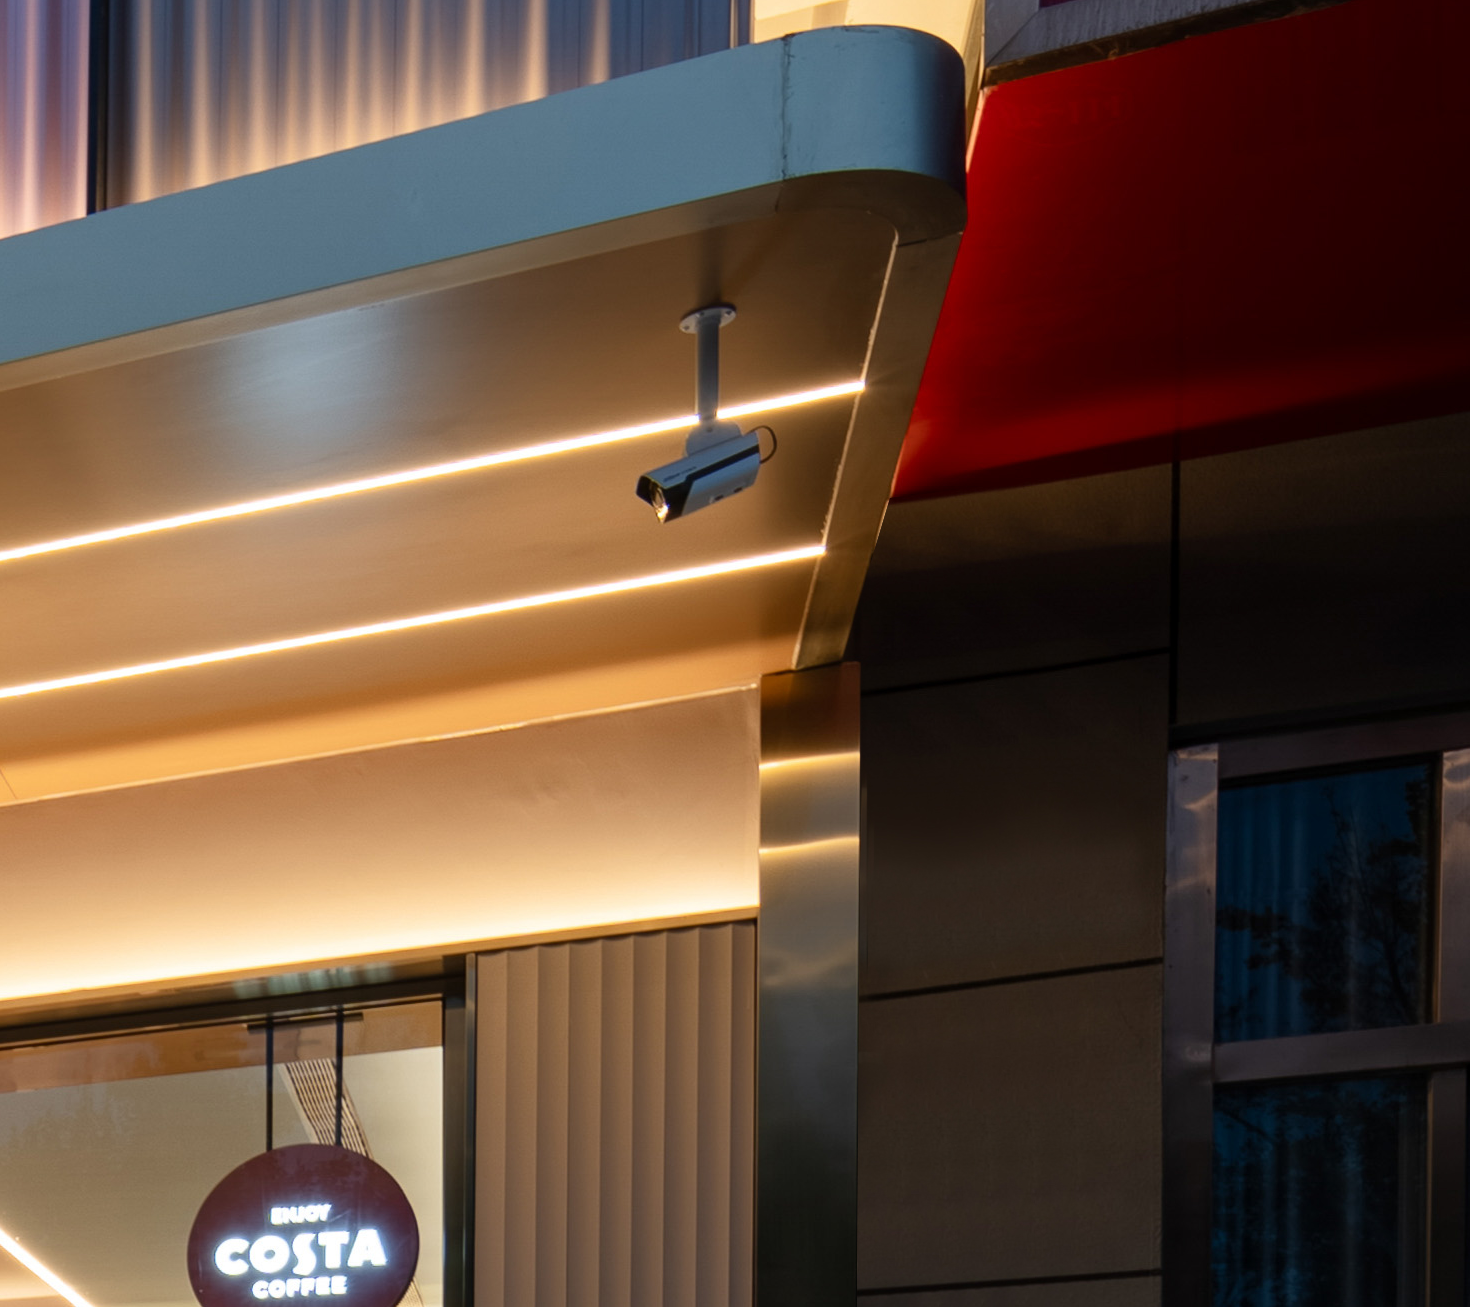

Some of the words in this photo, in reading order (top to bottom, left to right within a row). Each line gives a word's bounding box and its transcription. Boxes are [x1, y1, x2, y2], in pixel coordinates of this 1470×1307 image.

[270, 1203, 332, 1226] ENJOY
[213, 1227, 388, 1276] COSTA
[252, 1275, 348, 1299] COFFEE
